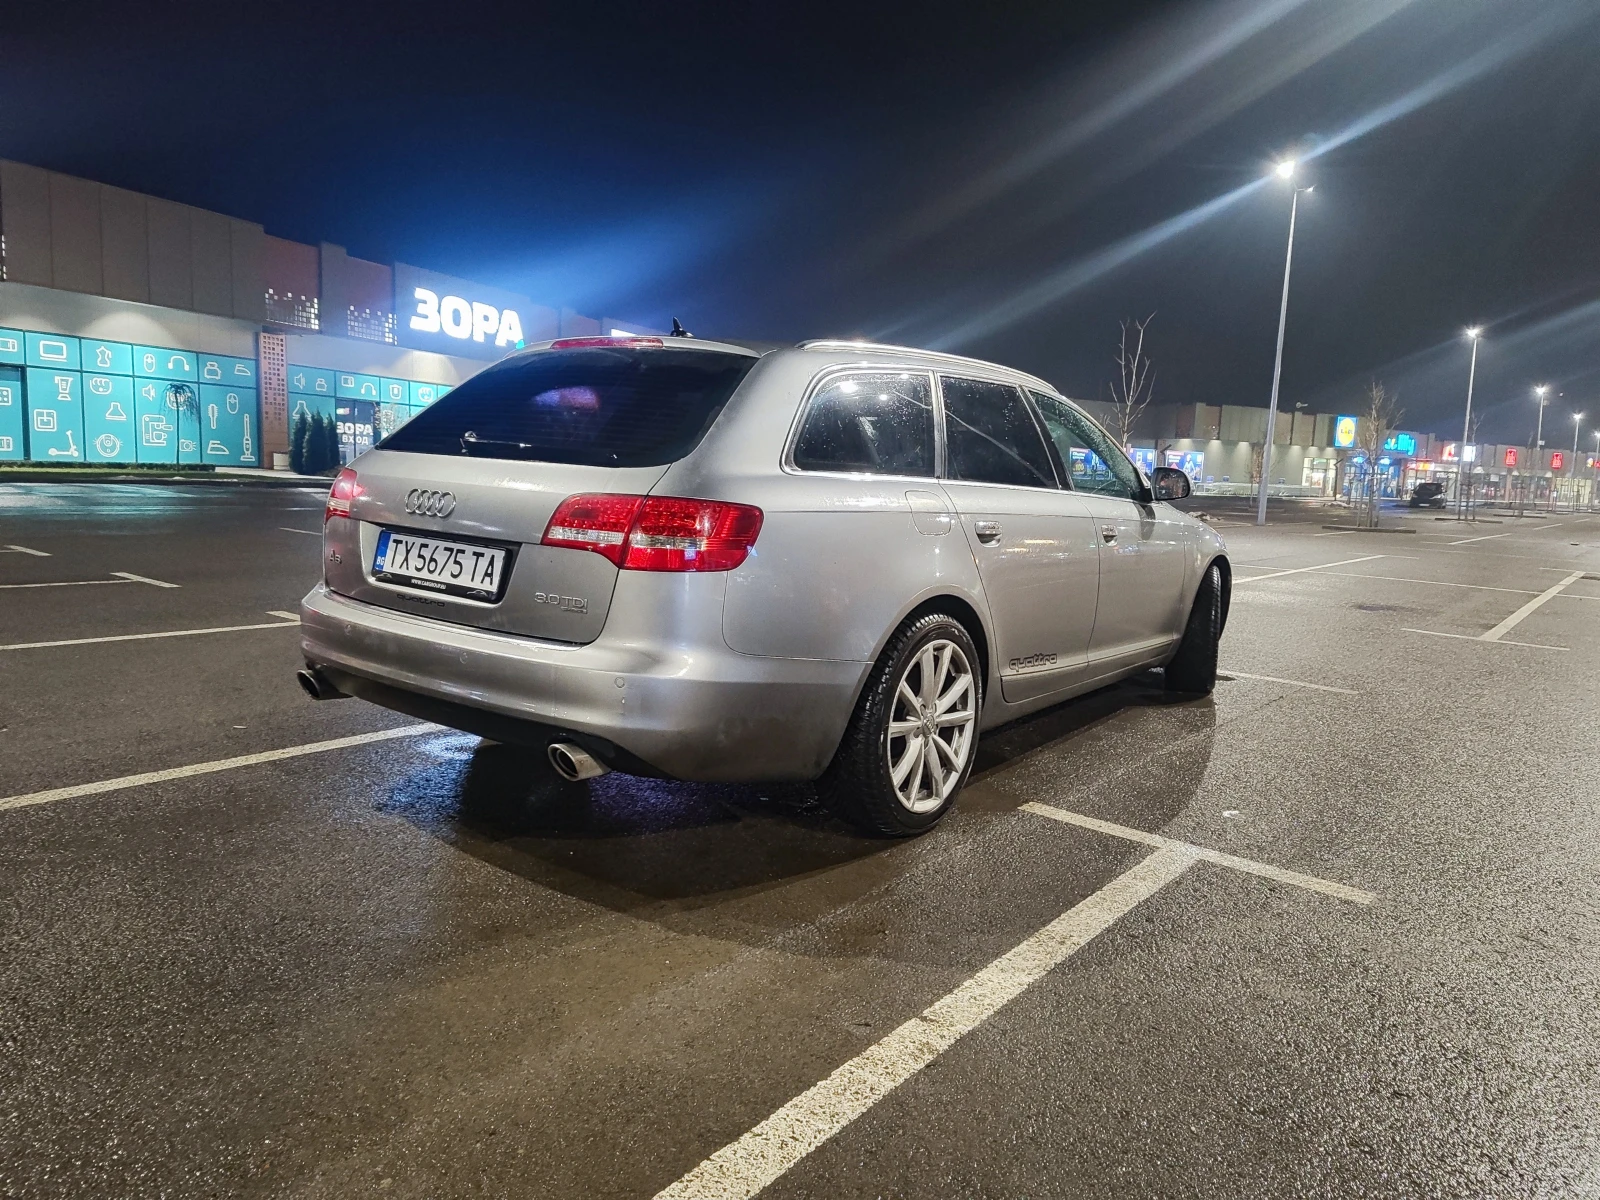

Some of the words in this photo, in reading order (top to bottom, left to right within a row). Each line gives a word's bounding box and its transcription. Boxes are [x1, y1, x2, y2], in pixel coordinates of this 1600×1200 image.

[410, 287, 524, 349] ЗОРА
[336, 421, 374, 436] ЗОРА
[341, 434, 369, 446] ВХОД
[397, 593, 446, 608] quattro
[1009, 653, 1057, 672] quattro
